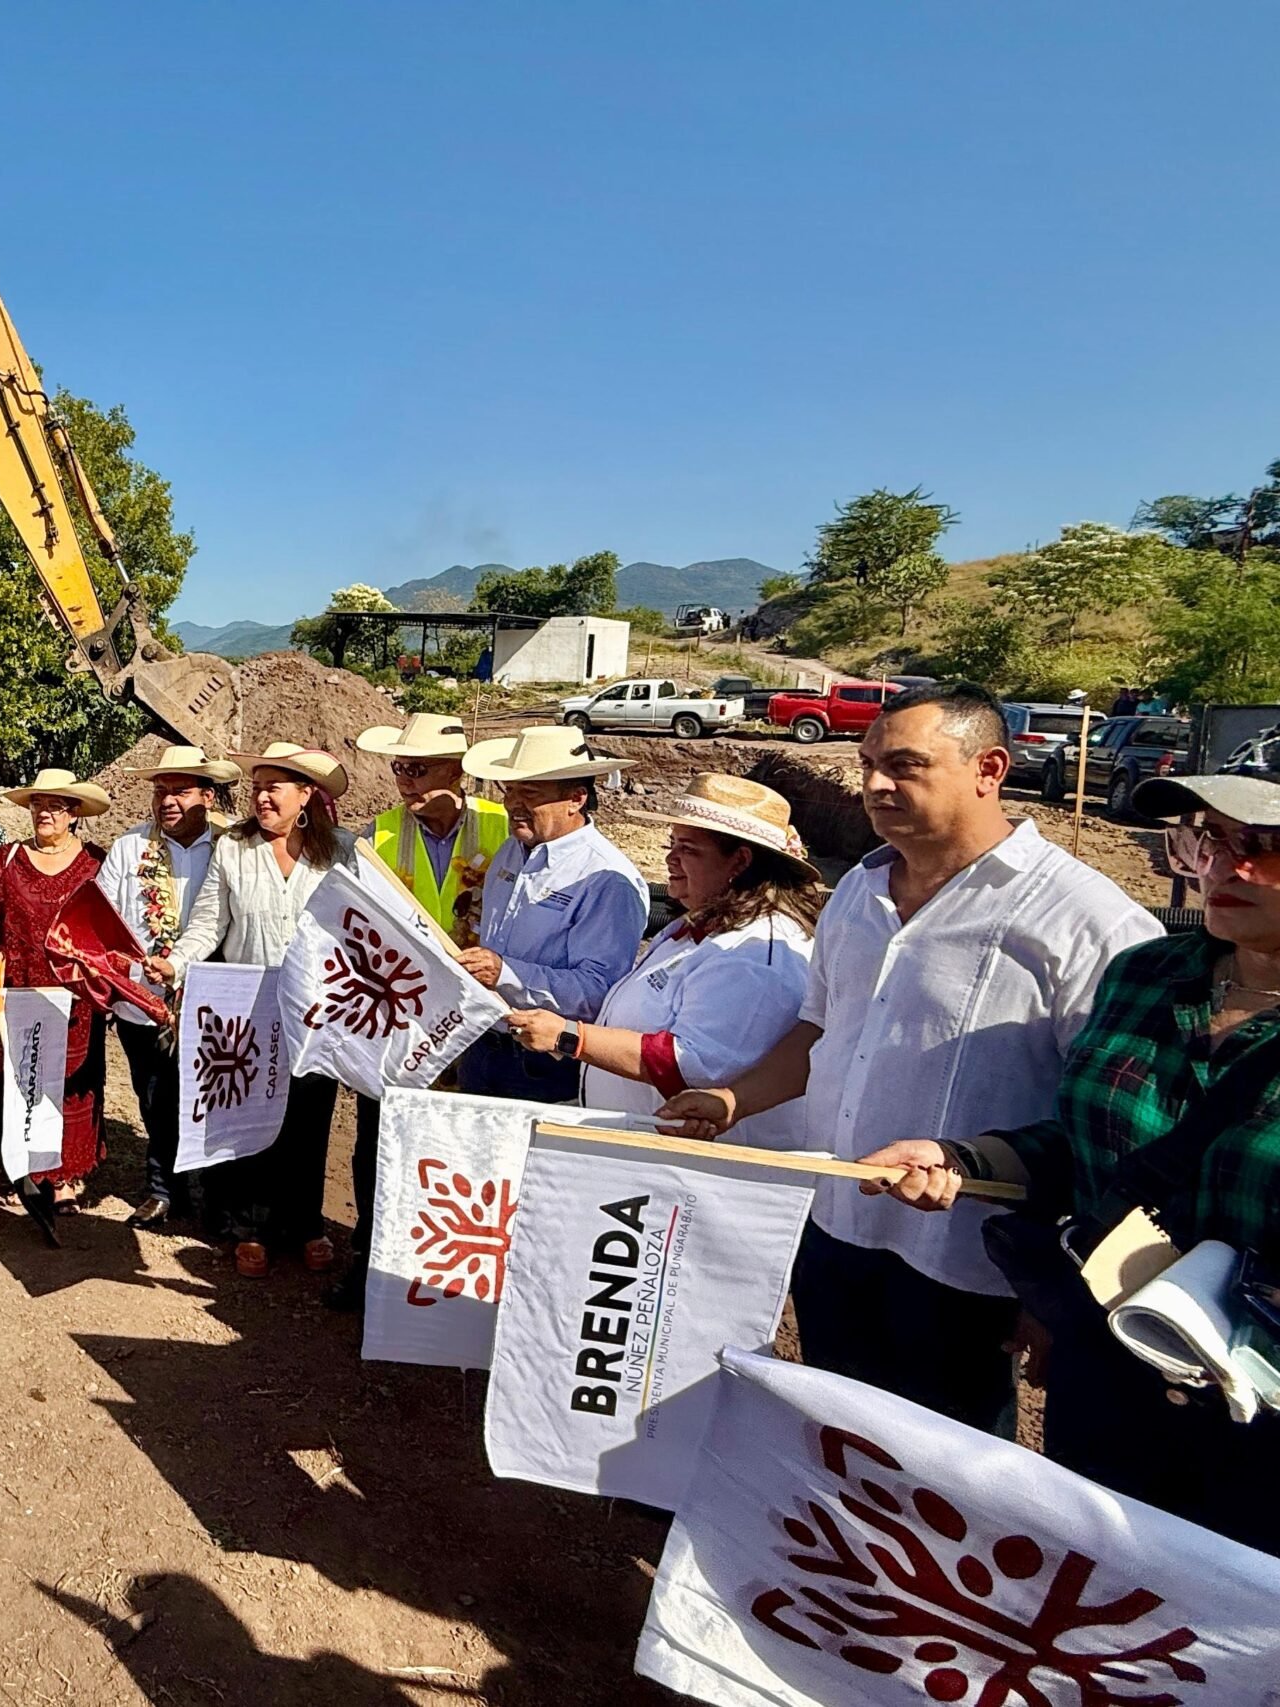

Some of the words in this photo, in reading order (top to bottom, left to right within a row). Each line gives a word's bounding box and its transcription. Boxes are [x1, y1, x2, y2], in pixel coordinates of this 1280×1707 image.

[266, 1021, 280, 1099] CAPASEG
[404, 1010, 464, 1071] CAPASEG
[24, 1021, 42, 1142] PUNGARABATO
[670, 1193, 697, 1277] PUNGARABATO
[570, 1194, 650, 1417] BRENDA
[636, 1229, 666, 1326] PEÑALOZA
[667, 1281, 678, 1297] DE
[623, 1331, 650, 1393] NÚÑEZ
[657, 1300, 676, 1364] MUNICIPAL
[646, 1366, 665, 1440] PRESIDENTA
